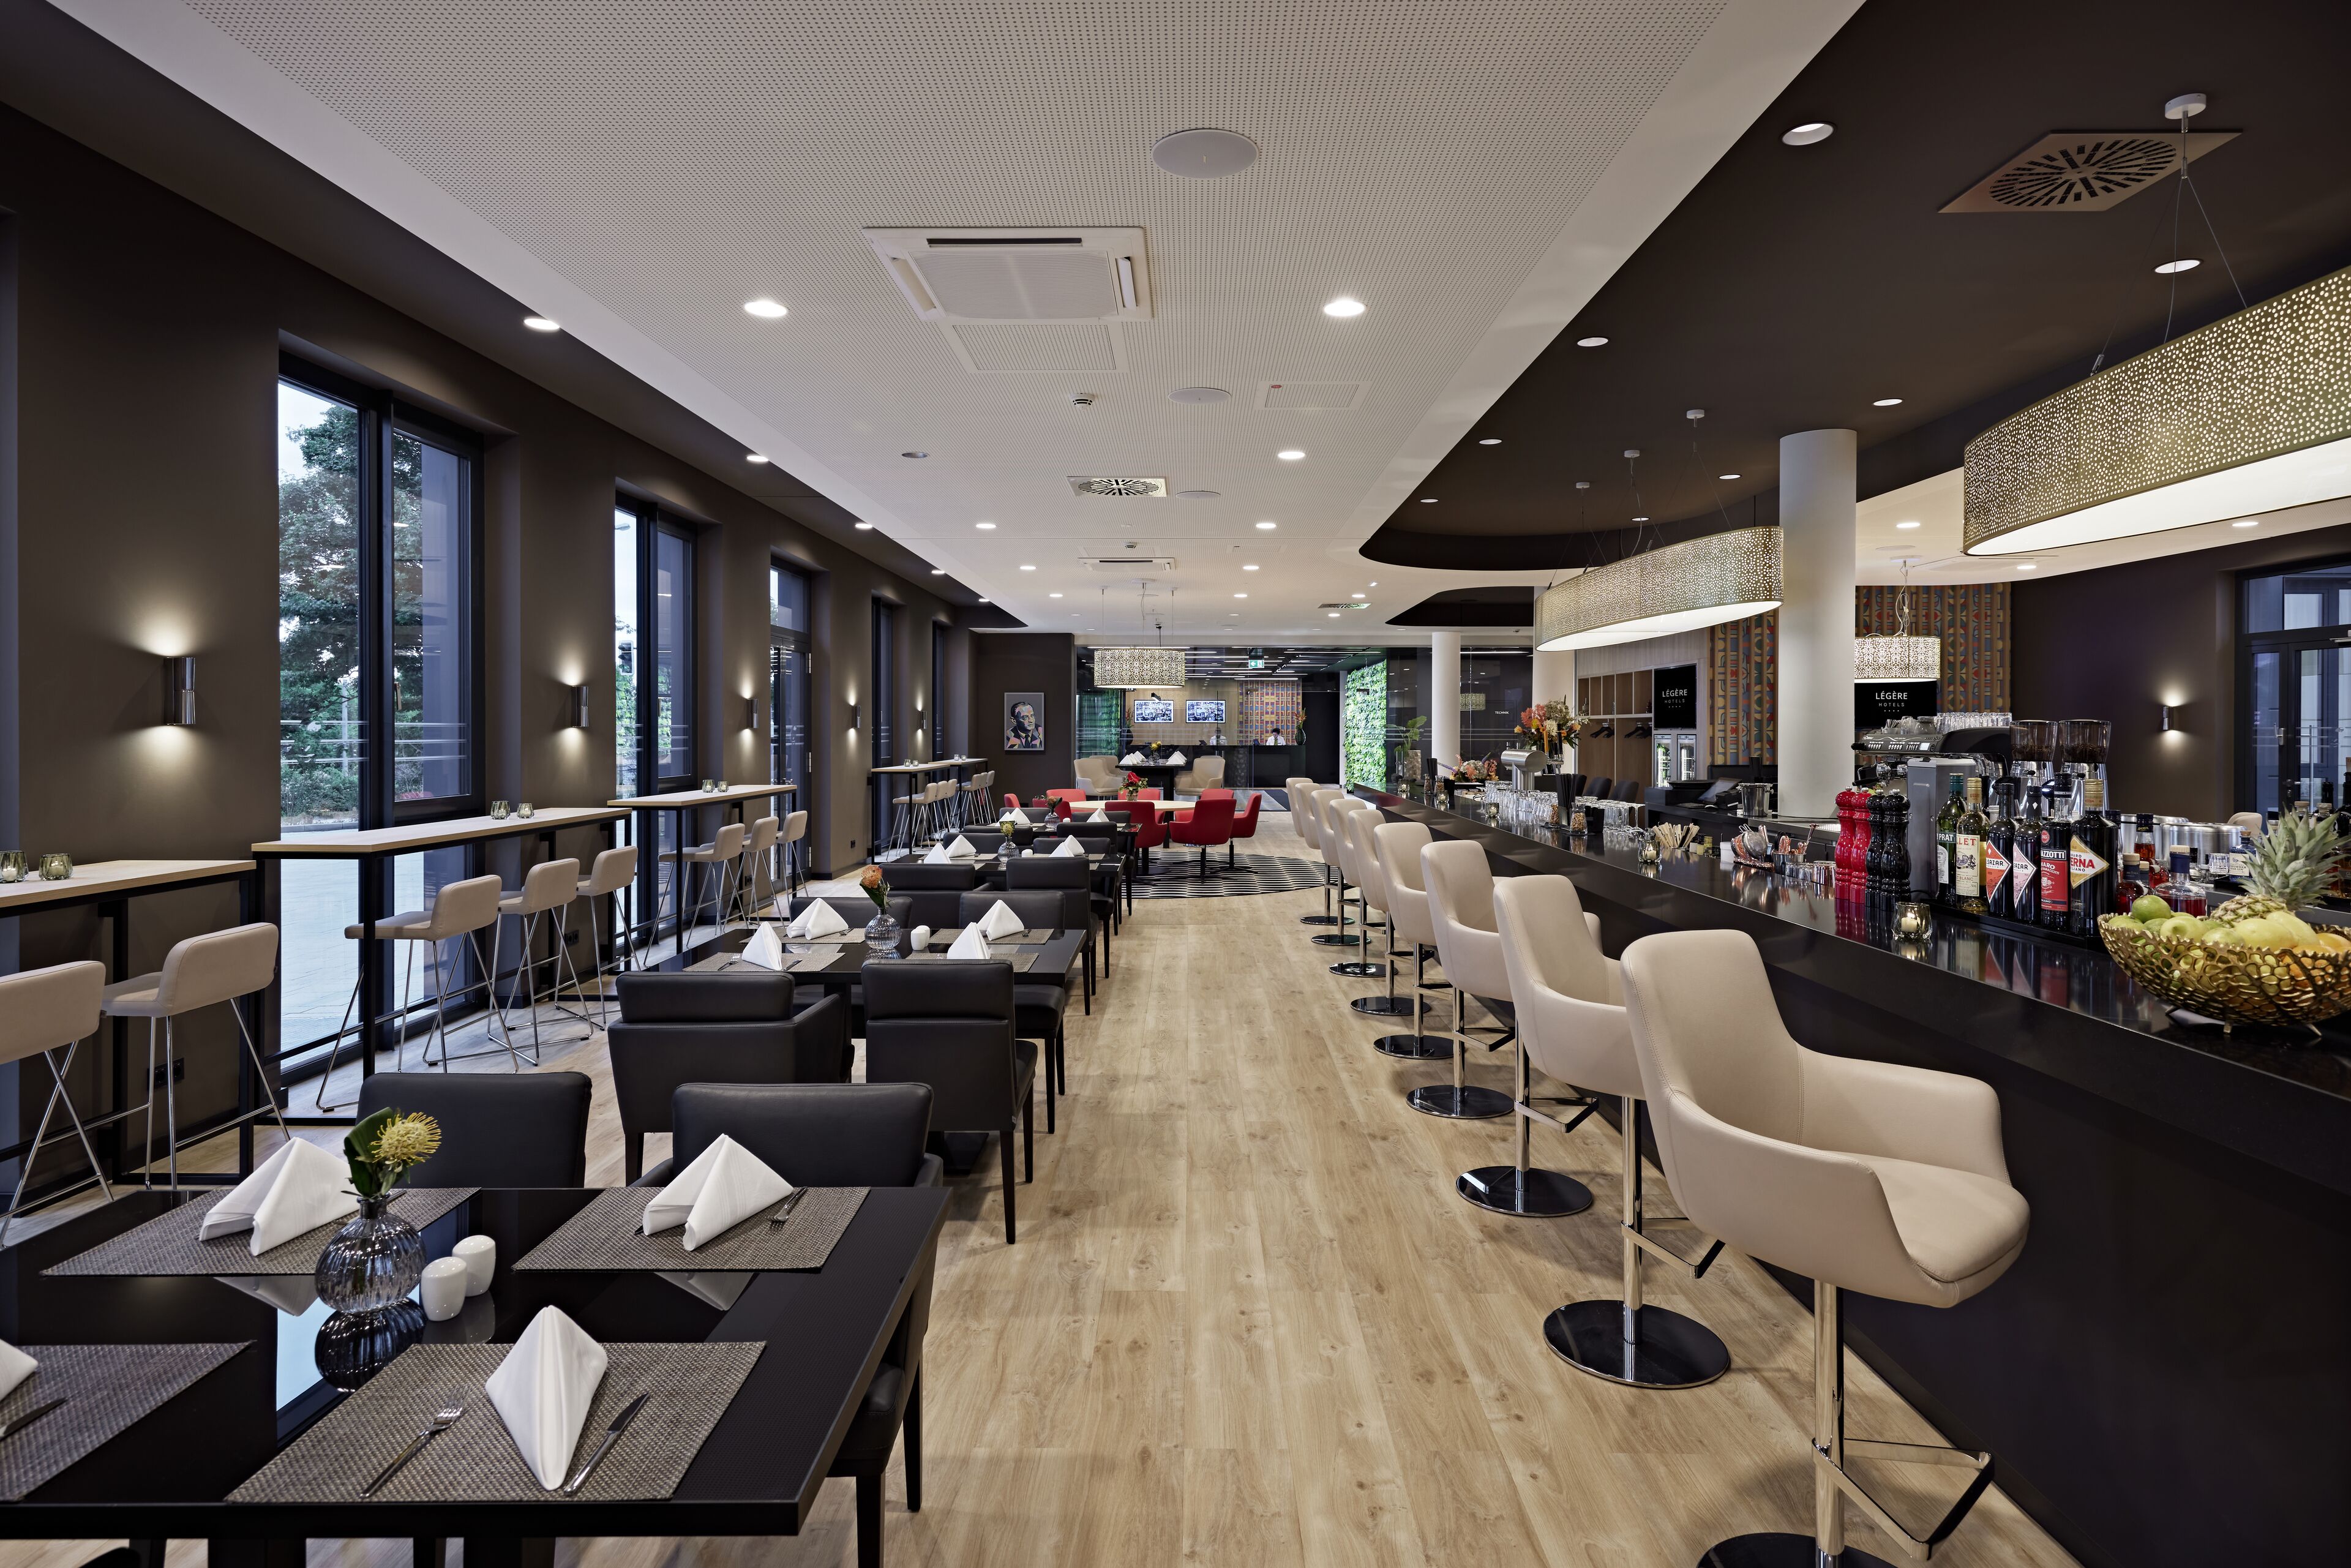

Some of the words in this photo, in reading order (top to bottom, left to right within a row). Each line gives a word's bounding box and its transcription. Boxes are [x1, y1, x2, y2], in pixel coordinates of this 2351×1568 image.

[1662, 688, 1688, 697] LÉGÈRE
[1875, 691, 1908, 700] LÉGÈRE
[1938, 833, 1954, 842] PRAT
[1957, 837, 1976, 846] LET
